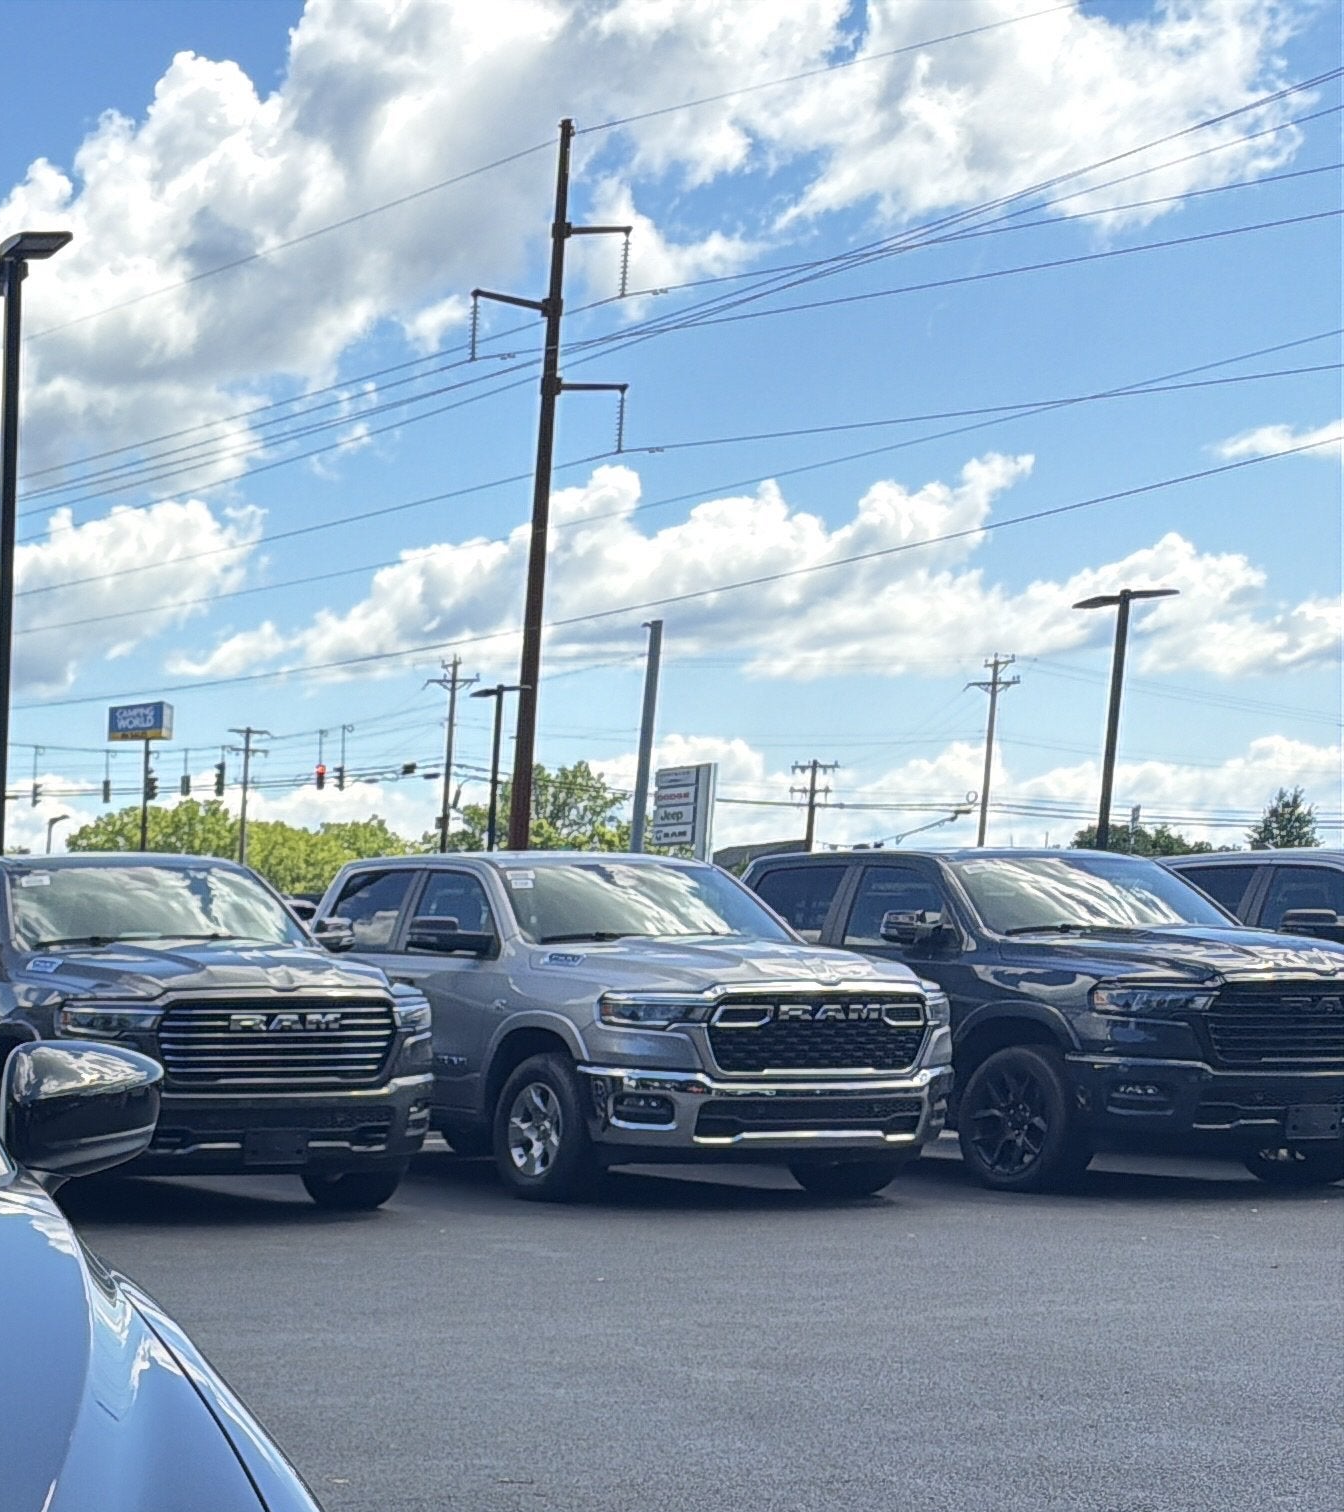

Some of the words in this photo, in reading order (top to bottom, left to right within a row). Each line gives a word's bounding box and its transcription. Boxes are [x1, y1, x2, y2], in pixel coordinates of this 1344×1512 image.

[117, 715, 155, 730] WORLD
[660, 809, 684, 822] Jeep
[778, 1004, 881, 1020] RAM
[229, 1013, 342, 1031] RAM
